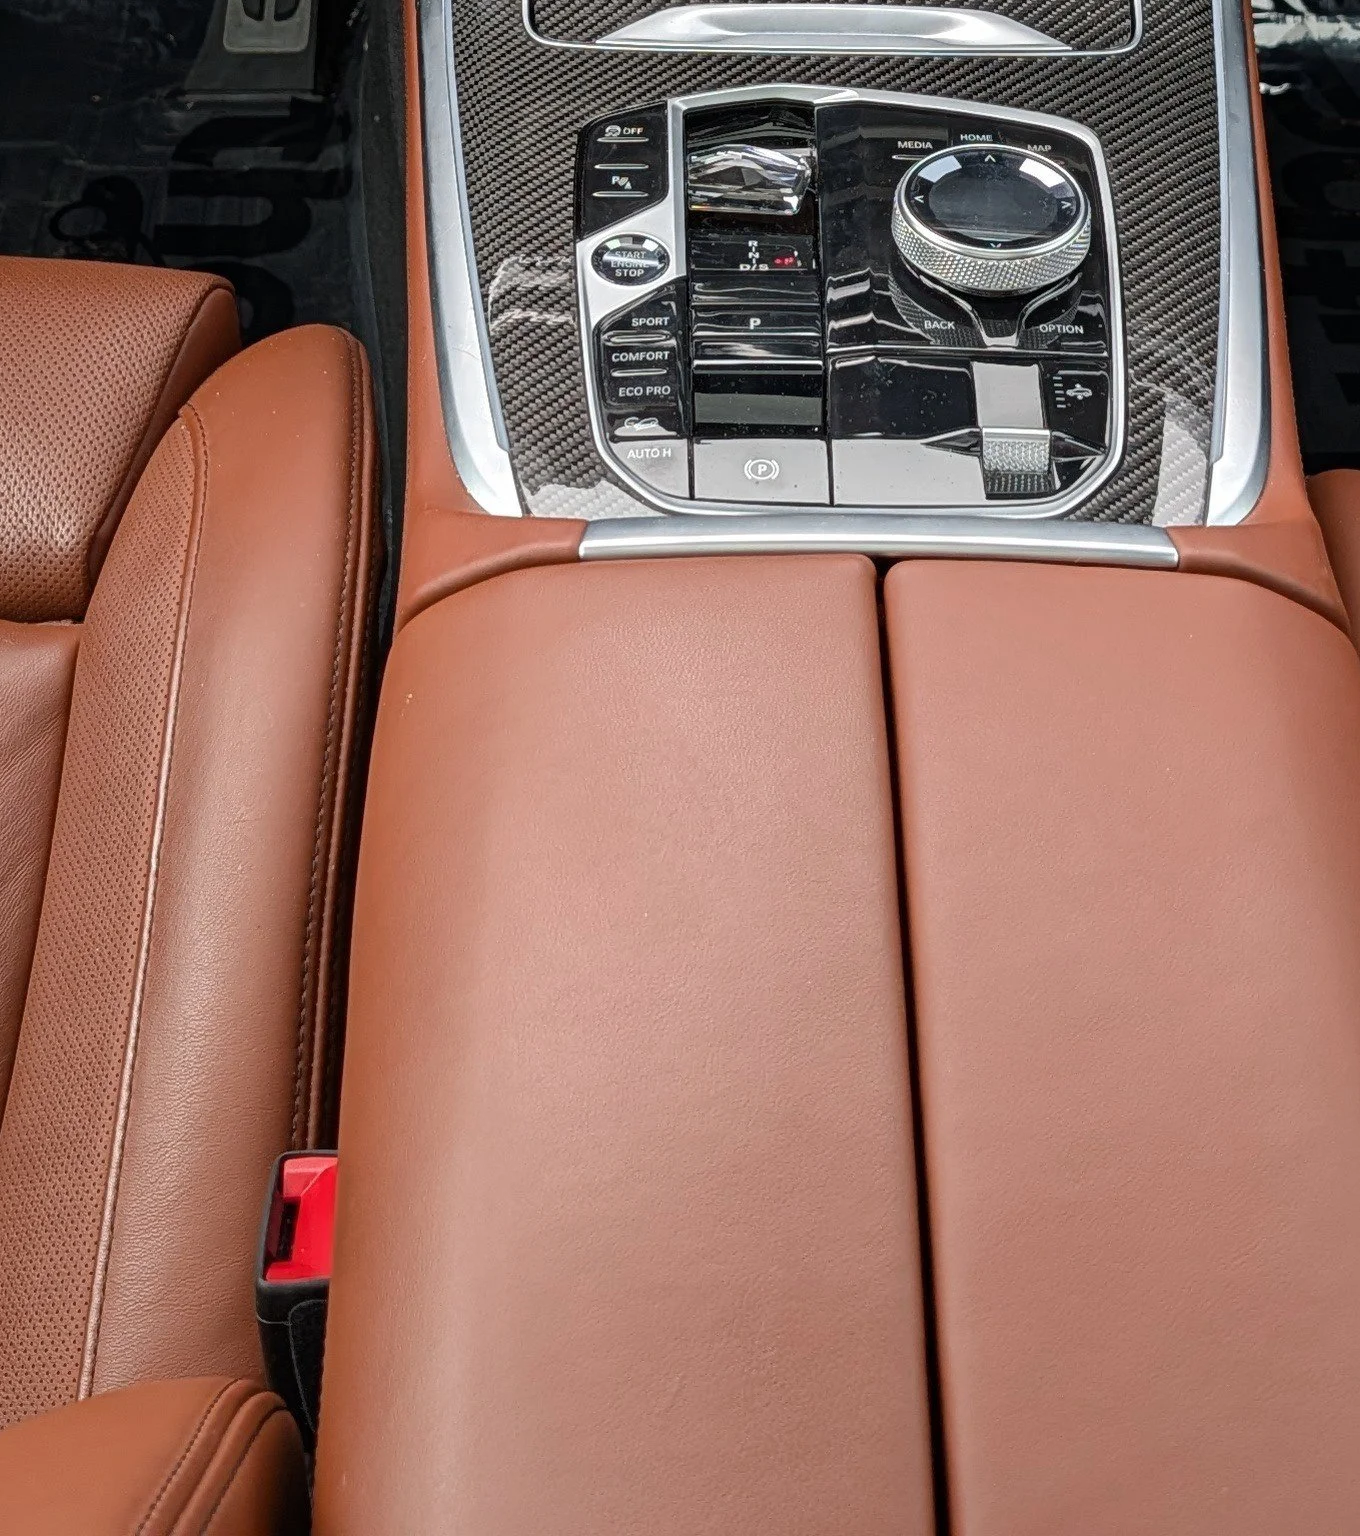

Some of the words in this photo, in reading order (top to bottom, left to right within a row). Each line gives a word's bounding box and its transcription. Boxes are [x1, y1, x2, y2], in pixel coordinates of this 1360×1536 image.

[622, 126, 644, 136] OFF
[959, 133, 993, 142] HOME
[897, 140, 933, 150] MEDIA
[1026, 143, 1052, 153] MAP
[614, 250, 647, 259] START
[610, 259, 650, 269] ENGINE
[614, 268, 645, 278] STOP
[631, 316, 670, 327] SPORT
[749, 317, 762, 330] P
[924, 319, 956, 330] BACK
[1039, 323, 1084, 334] OPTION
[611, 350, 671, 363] COMFORT
[618, 386, 644, 398] ECO
[645, 385, 672, 397] PRO
[626, 448, 660, 460] AUTO
[661, 447, 672, 459] H
